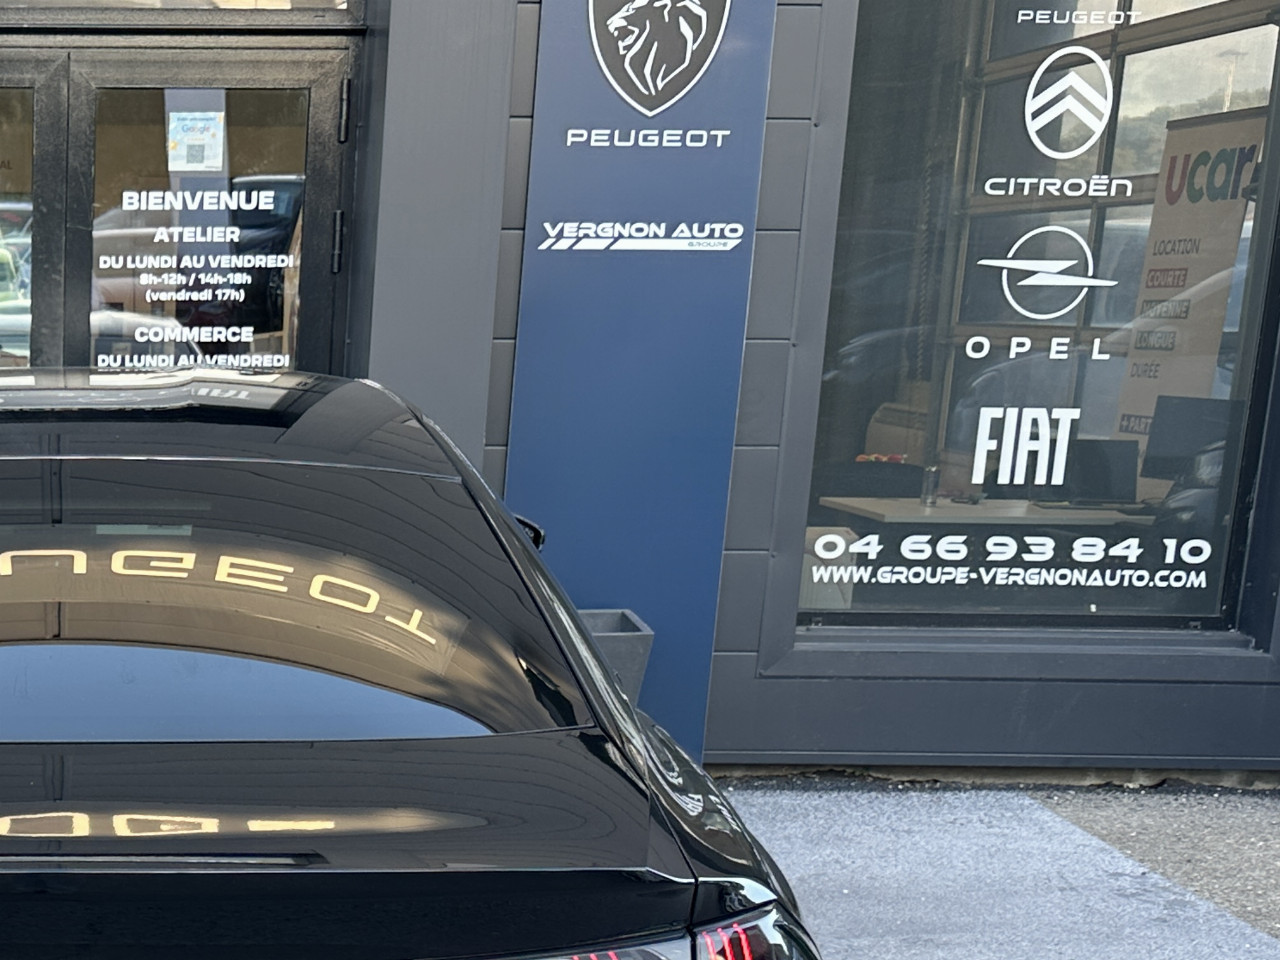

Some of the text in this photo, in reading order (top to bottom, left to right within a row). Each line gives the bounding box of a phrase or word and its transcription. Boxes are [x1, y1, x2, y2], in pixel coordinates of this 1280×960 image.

[1017, 10, 1141, 24] PEUGEOT
[566, 129, 730, 147] PEUGEOT
[984, 175, 1133, 197] CITROËN
[122, 191, 275, 211] BIENVENUE
[153, 227, 240, 243] ATELIER
[543, 222, 744, 238] VERGNON AUTO
[1153, 238, 1201, 256] LOCATION
[99, 255, 294, 268] DU LUNDI AU VENDREDI
[145, 289, 246, 302] (vendredi 17h)
[134, 327, 254, 342] COMMERCE
[965, 336, 1111, 360] OPEL
[97, 354, 289, 367] DU LUNDI AU VENDREDI
[971, 407, 1081, 485] FIAT
[814, 534, 1212, 564] 04 66 93 84 10
